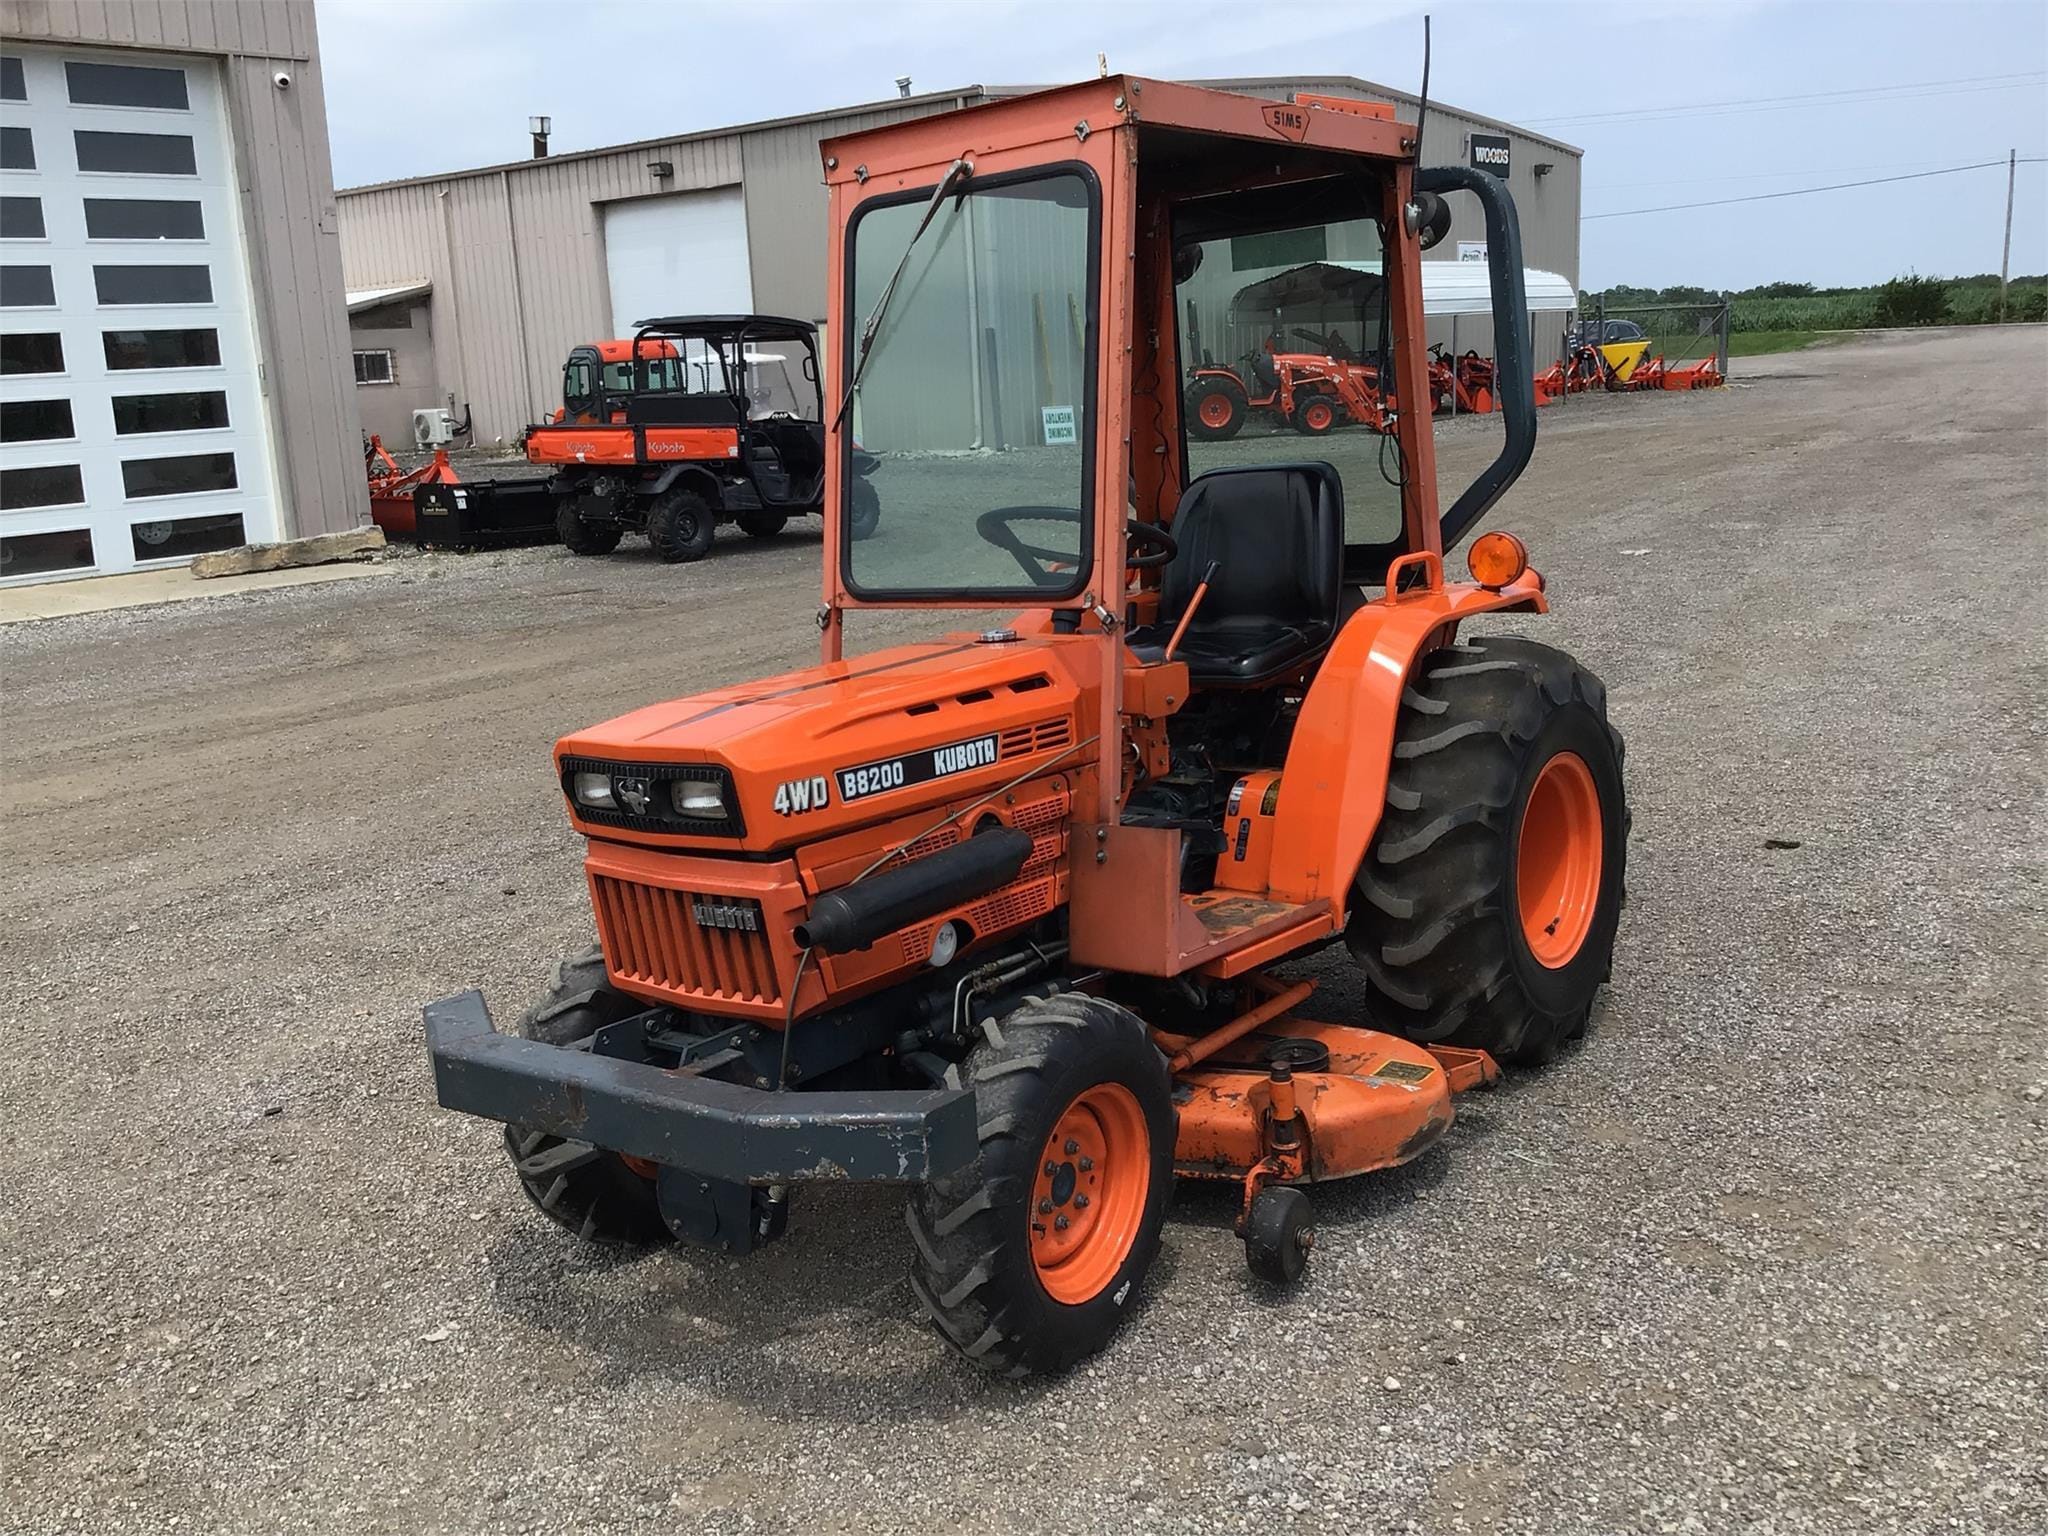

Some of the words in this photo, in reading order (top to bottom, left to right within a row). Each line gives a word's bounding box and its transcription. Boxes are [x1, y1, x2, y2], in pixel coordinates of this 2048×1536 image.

[1273, 110, 1302, 129] SIMS
[1475, 146, 1509, 165] WOODS
[566, 441, 596, 453] Kubota
[648, 441, 685, 453] Kubota
[933, 737, 996, 776] KUBOTA
[773, 775, 829, 816] 4WD
[843, 761, 904, 798] B8200
[692, 904, 757, 931] KUBOTA
